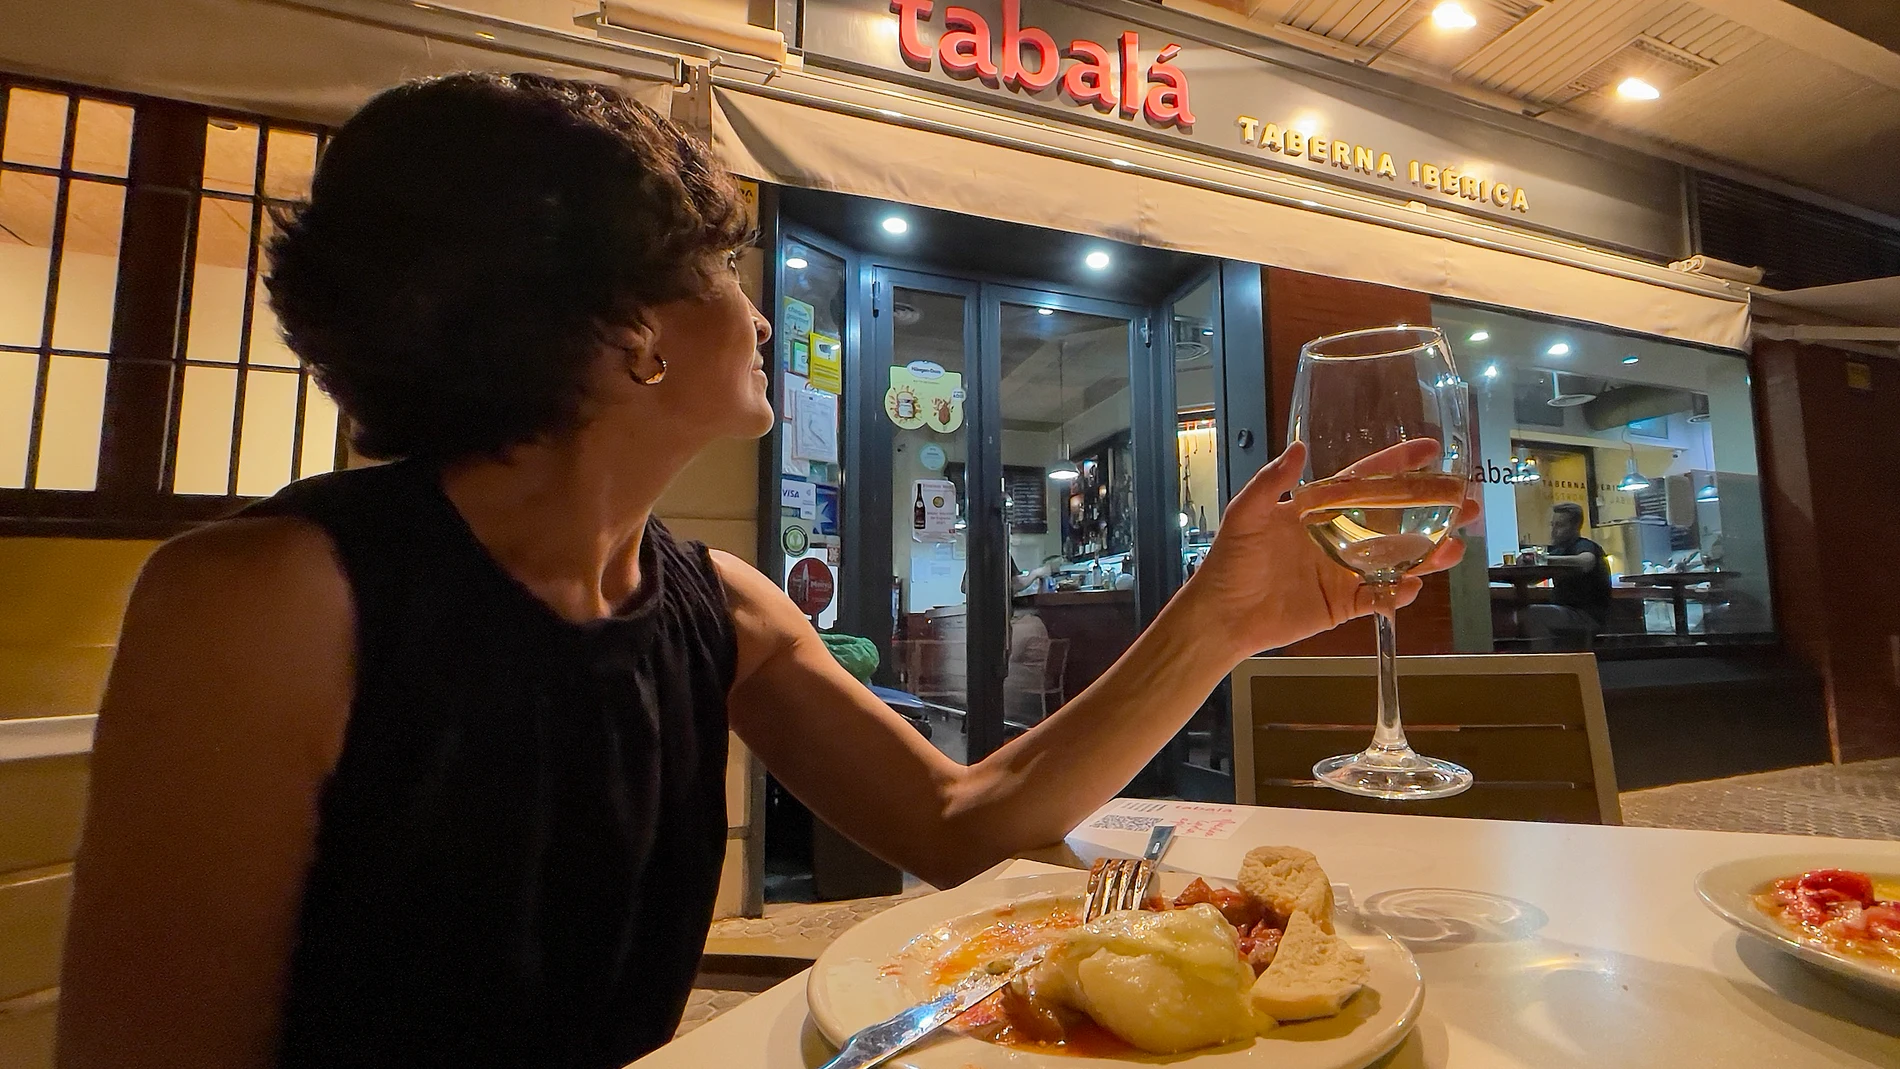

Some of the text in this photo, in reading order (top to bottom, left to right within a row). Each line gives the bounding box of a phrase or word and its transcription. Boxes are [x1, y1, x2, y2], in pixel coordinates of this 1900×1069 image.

[889, 0, 1196, 127] tabalá
[1238, 115, 1530, 212] TABERNA IBÉRICA
[782, 489, 800, 498] VISA
